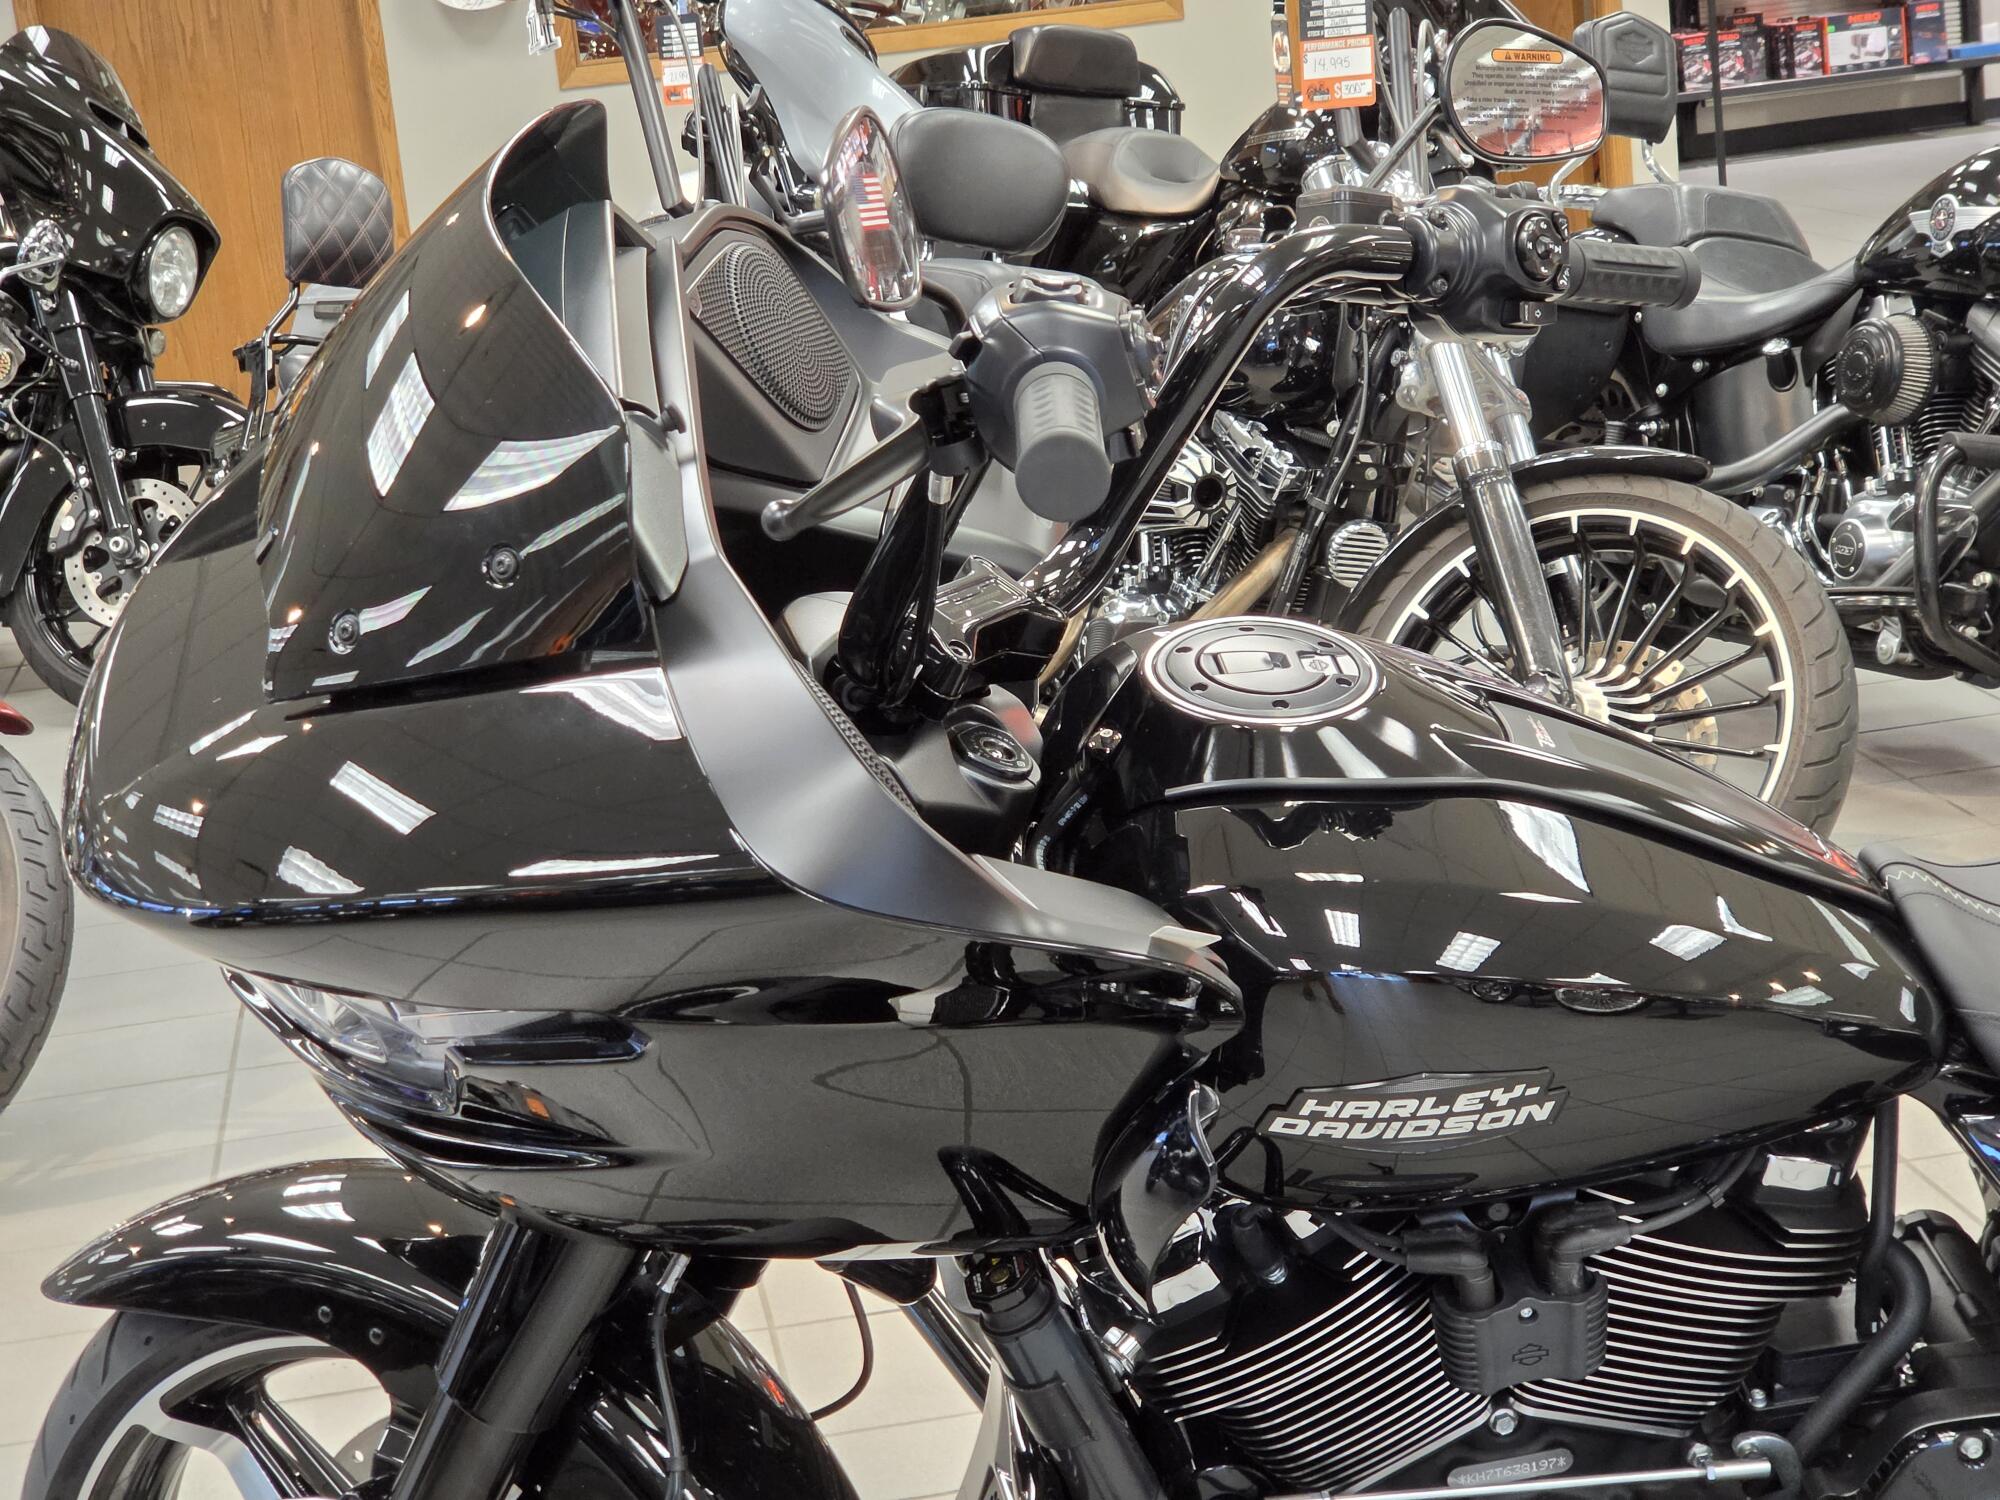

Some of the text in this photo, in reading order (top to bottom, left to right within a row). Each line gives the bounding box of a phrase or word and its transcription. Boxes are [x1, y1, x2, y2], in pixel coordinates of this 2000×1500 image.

[1847, 12, 1882, 24] NEBO
[1513, 53, 1552, 61] WARNING
[1334, 82, 1342, 99] $
[1299, 1083, 1541, 1119] HARLEY-
[1268, 1101, 1556, 1139] DAVIDSON
